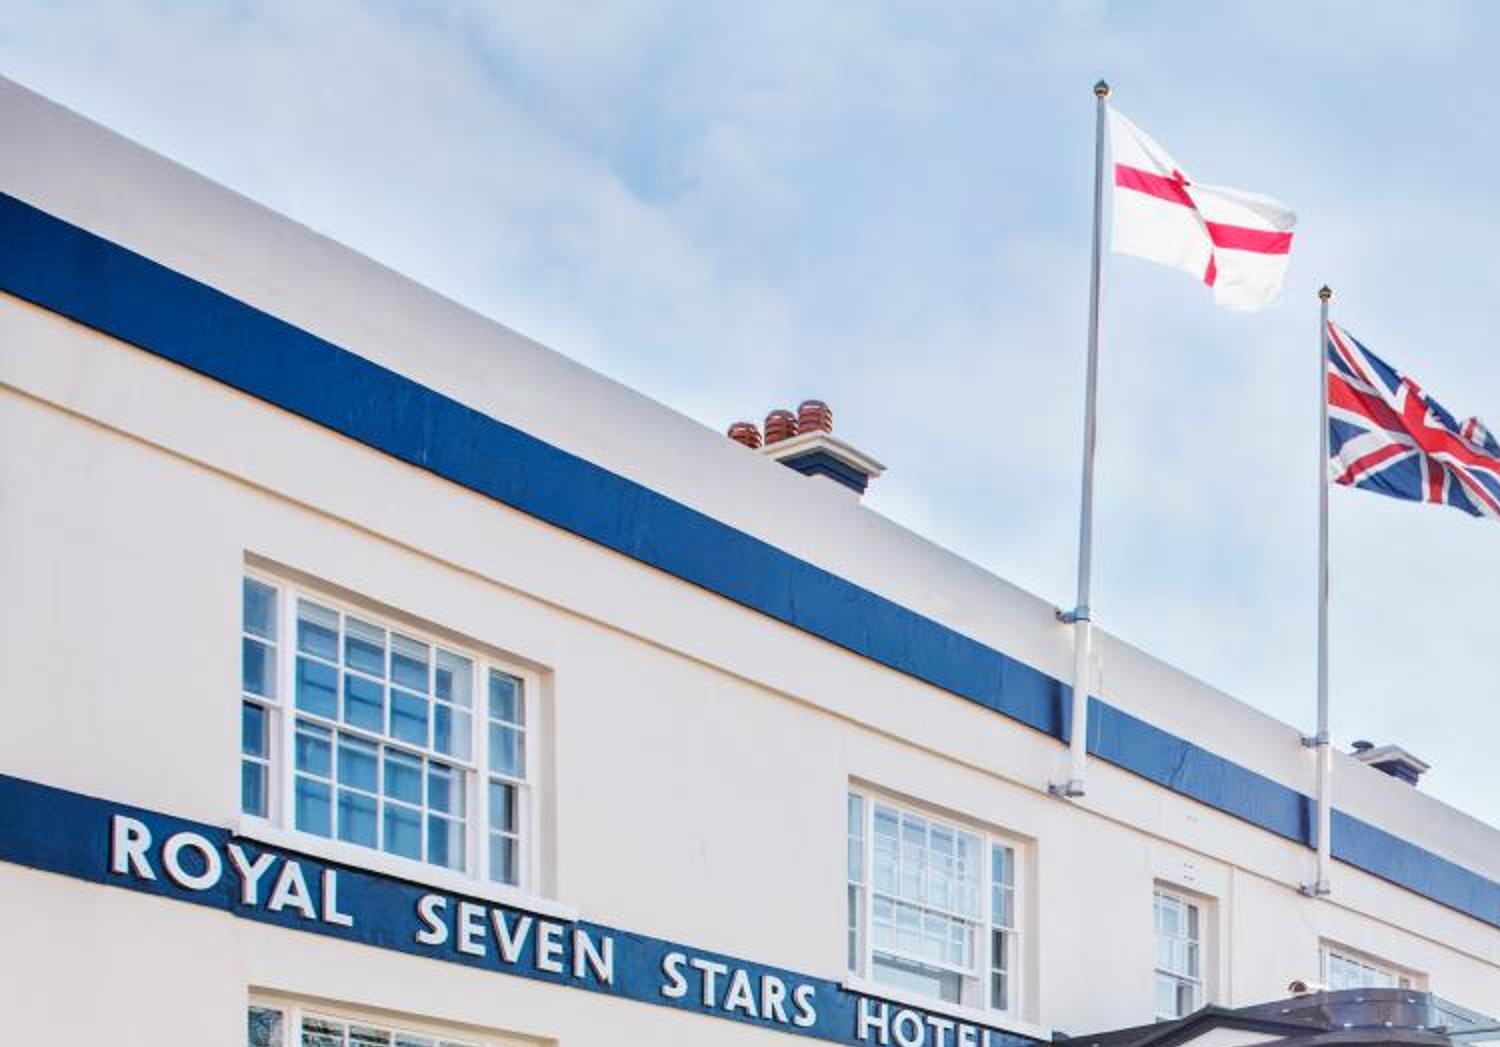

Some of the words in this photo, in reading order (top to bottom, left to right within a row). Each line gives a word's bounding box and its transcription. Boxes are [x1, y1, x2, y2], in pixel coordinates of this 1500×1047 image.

[109, 813, 354, 928] ROYAL
[414, 892, 615, 986] SEVEN
[660, 951, 818, 1028] STARS
